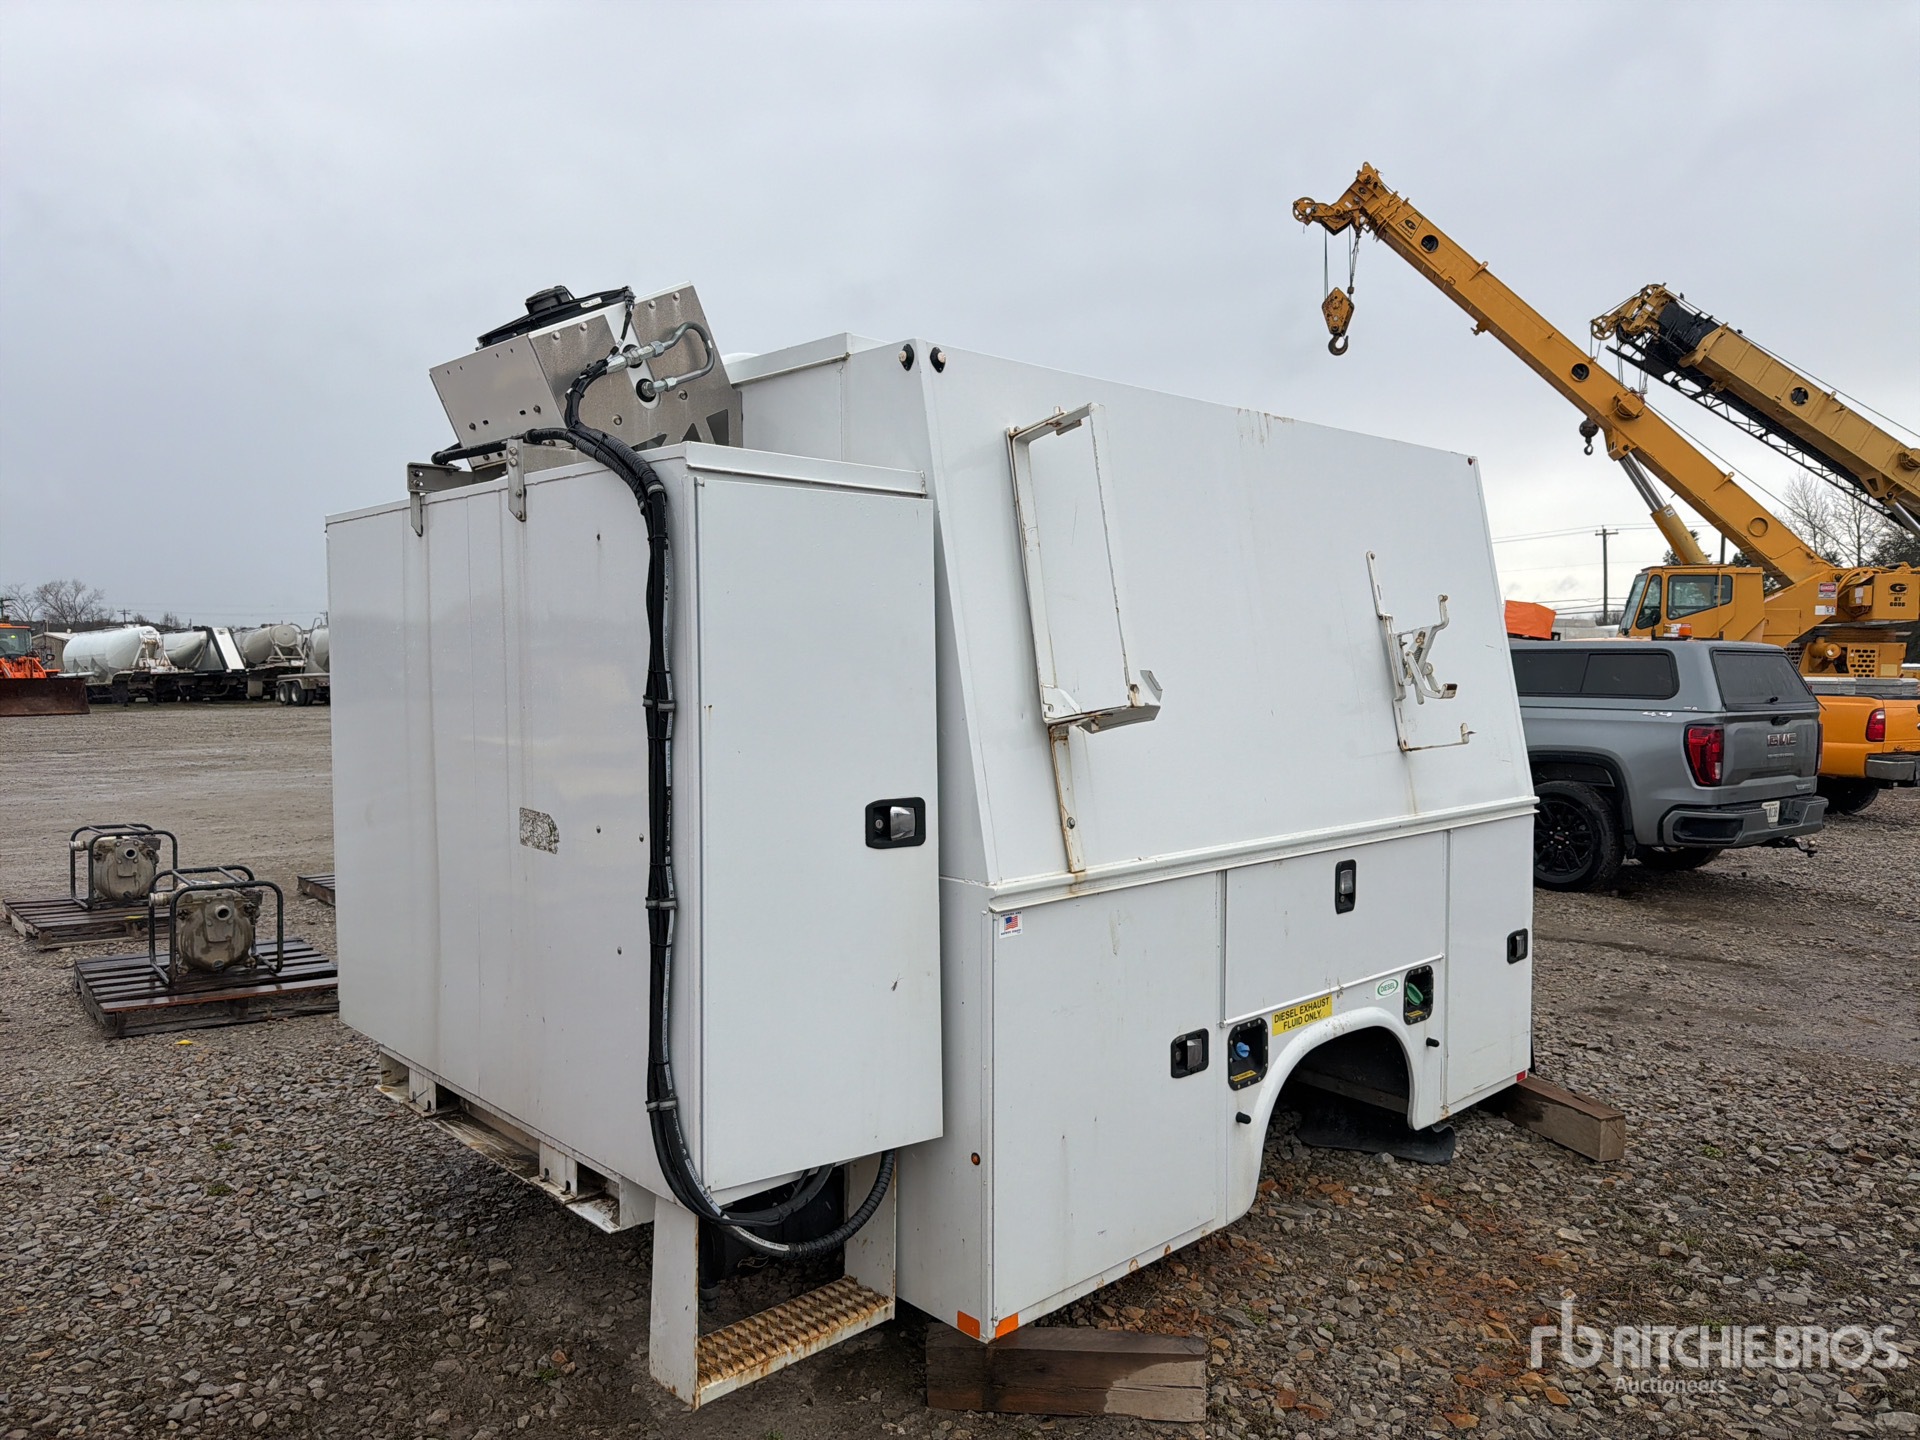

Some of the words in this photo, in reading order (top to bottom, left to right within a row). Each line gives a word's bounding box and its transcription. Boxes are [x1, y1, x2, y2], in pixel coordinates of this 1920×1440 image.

[1767, 733, 1797, 747] GMC
[1274, 1008, 1299, 1023] DIESEL
[1299, 996, 1330, 1015] EXHAUST
[1283, 1016, 1303, 1030] FLUID
[1304, 1009, 1322, 1023] ONLY
